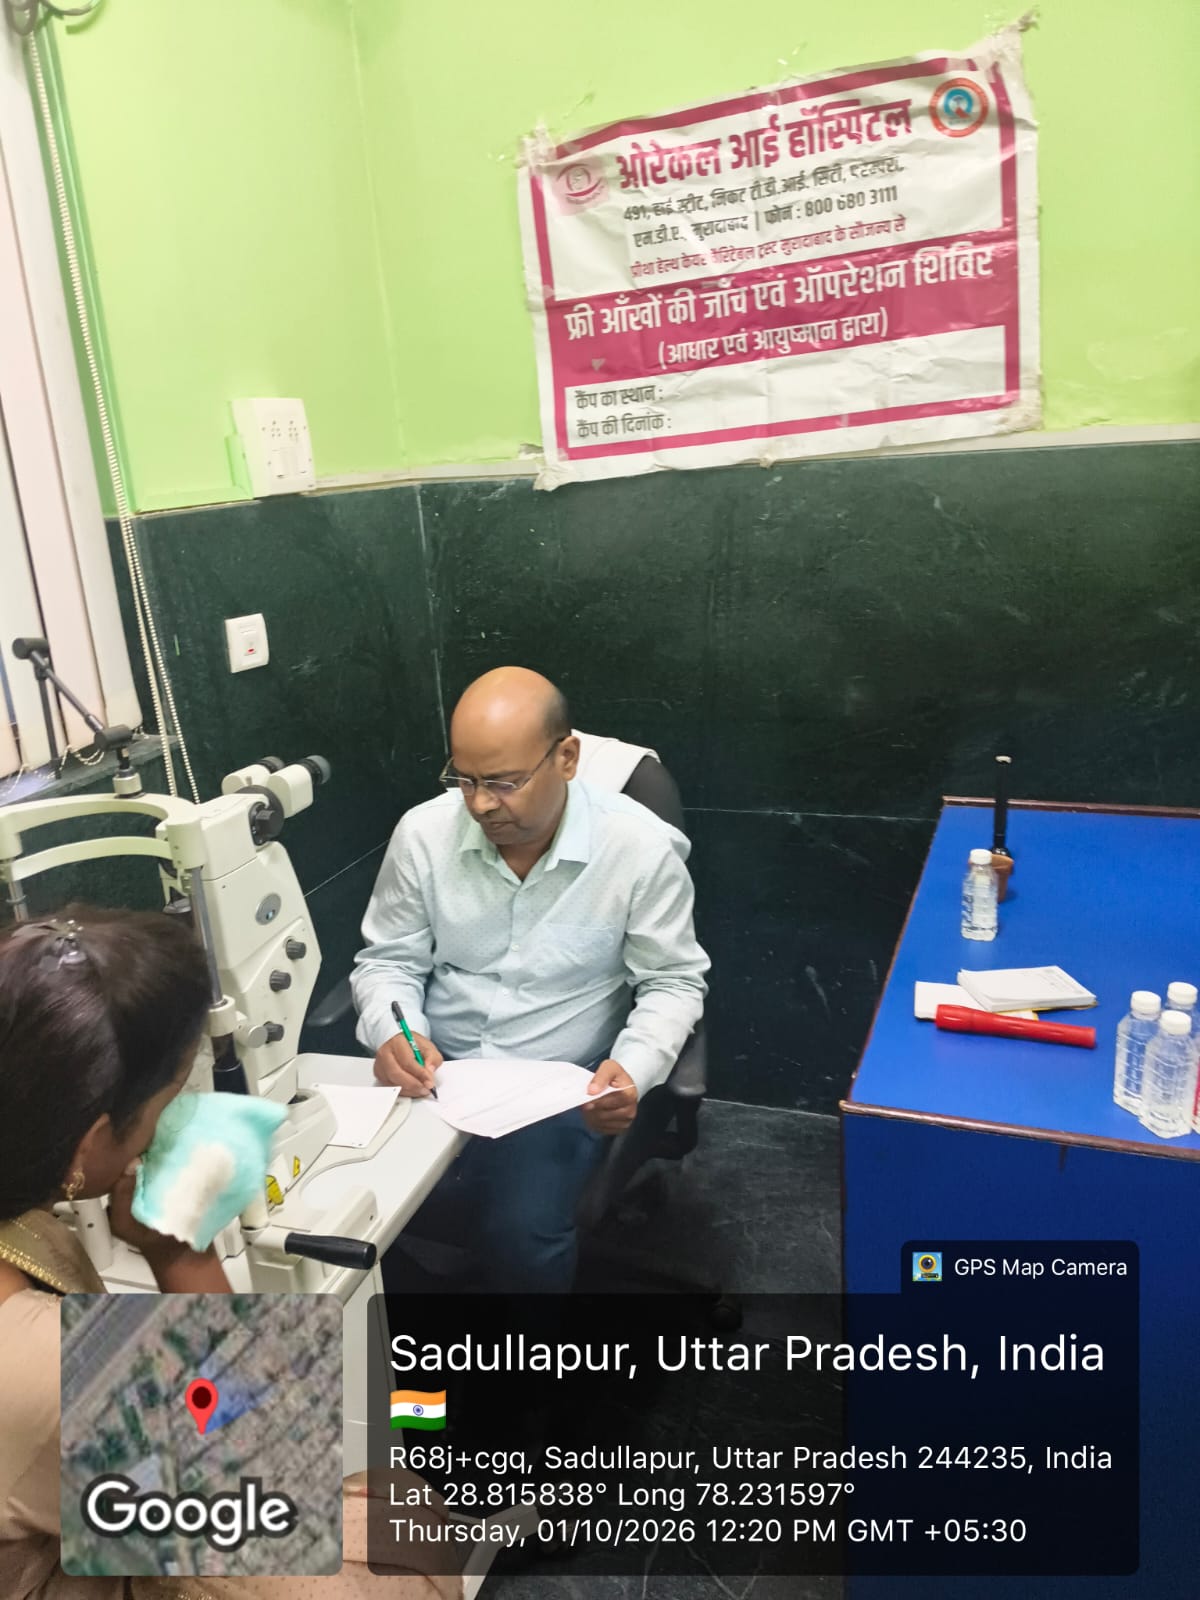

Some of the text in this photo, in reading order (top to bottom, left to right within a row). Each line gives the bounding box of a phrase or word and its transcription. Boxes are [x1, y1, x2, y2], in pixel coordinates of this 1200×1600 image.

[616, 98, 912, 189] ओरेकल आई हॉस्पिटल
[623, 203, 651, 222] 491,
[764, 203, 794, 225] फोन
[804, 197, 833, 217] 800
[836, 191, 866, 211] 680
[869, 185, 899, 205] 3111
[833, 225, 847, 242] के
[892, 214, 907, 232] से
[564, 240, 994, 341] फ्री आँखों की जाँच एवं ऑपरेशन शिविर
[658, 307, 890, 370] (आधार एवं आयुष्मान द्वारा)
[600, 387, 618, 407] का
[619, 384, 657, 406] स्थान
[600, 415, 619, 435] की
[620, 411, 666, 434] दिनांक
